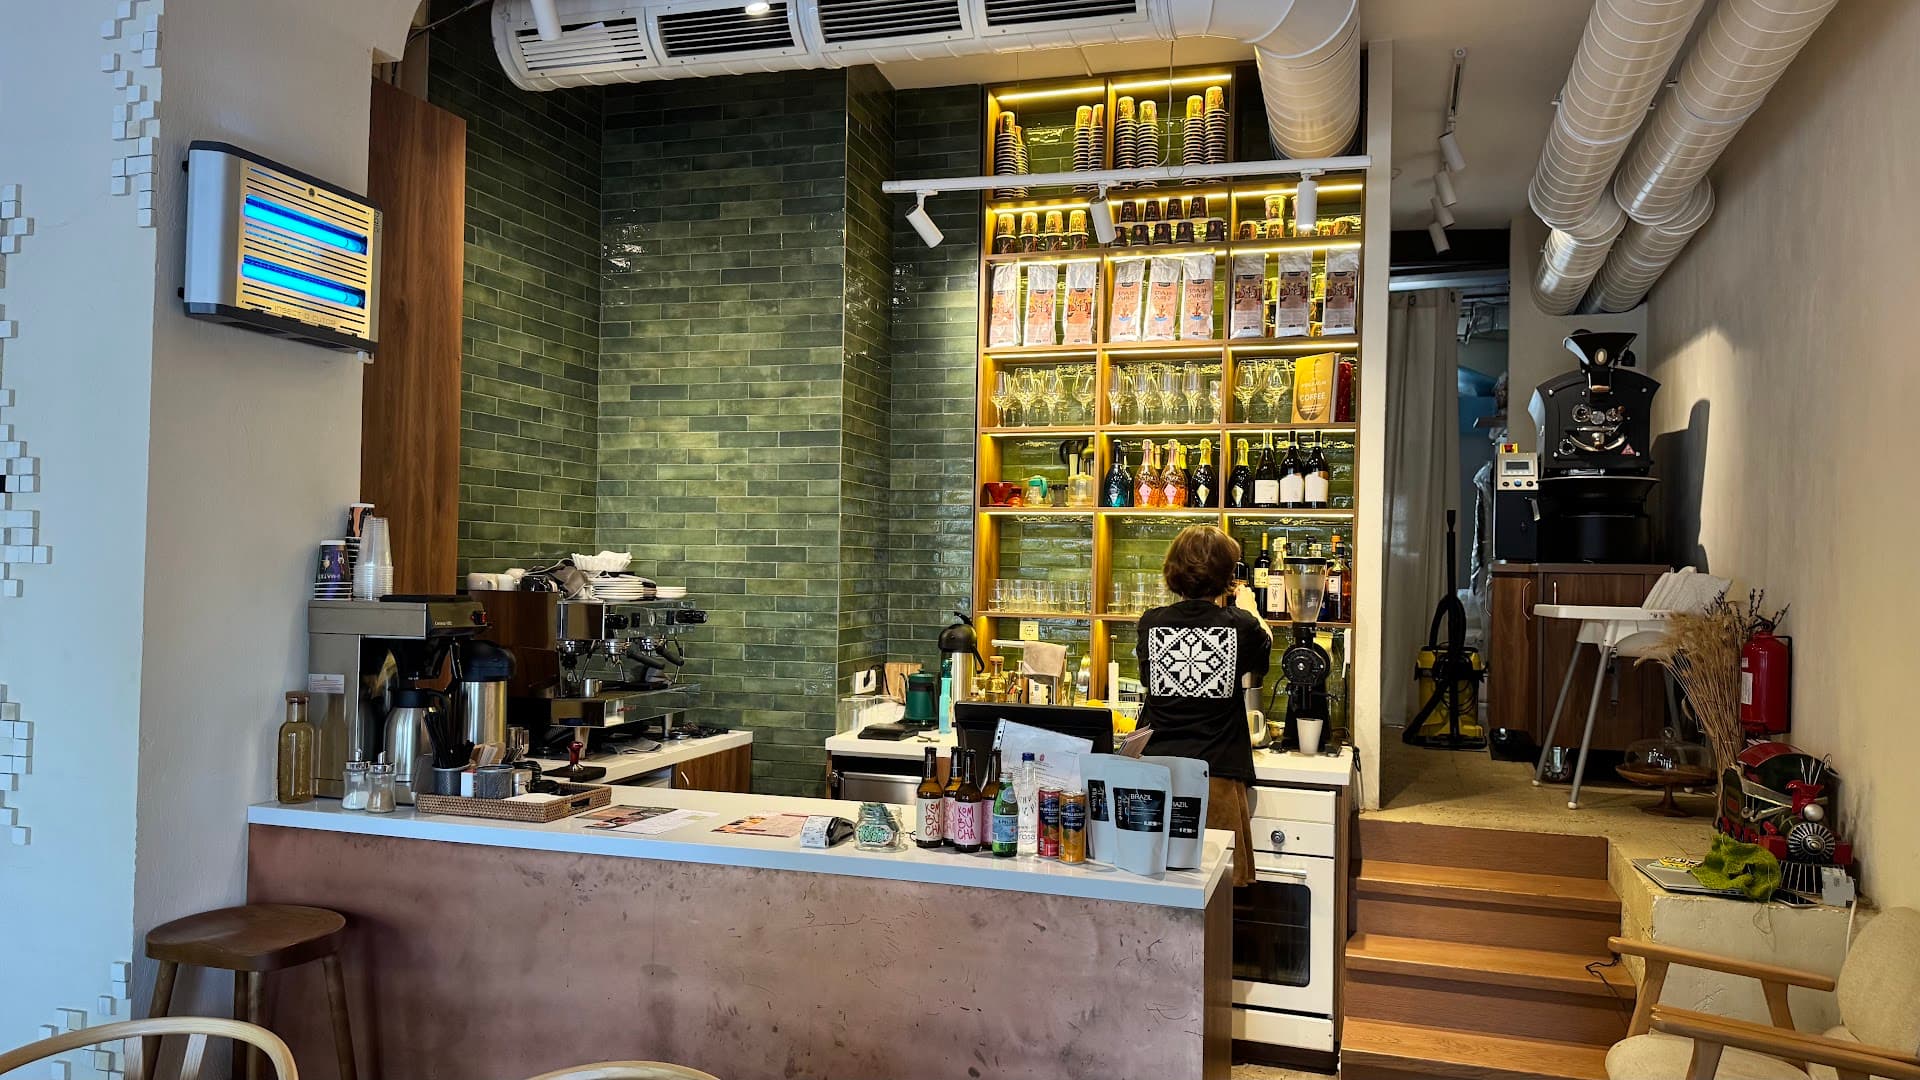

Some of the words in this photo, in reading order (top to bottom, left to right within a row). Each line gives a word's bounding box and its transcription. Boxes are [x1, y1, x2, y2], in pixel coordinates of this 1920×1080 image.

[1300, 392, 1326, 402] COFFEE
[1130, 793, 1153, 801] BRAZIL
[958, 804, 974, 819] KOM
[958, 818, 974, 829] BU
[958, 829, 976, 841] CHA
